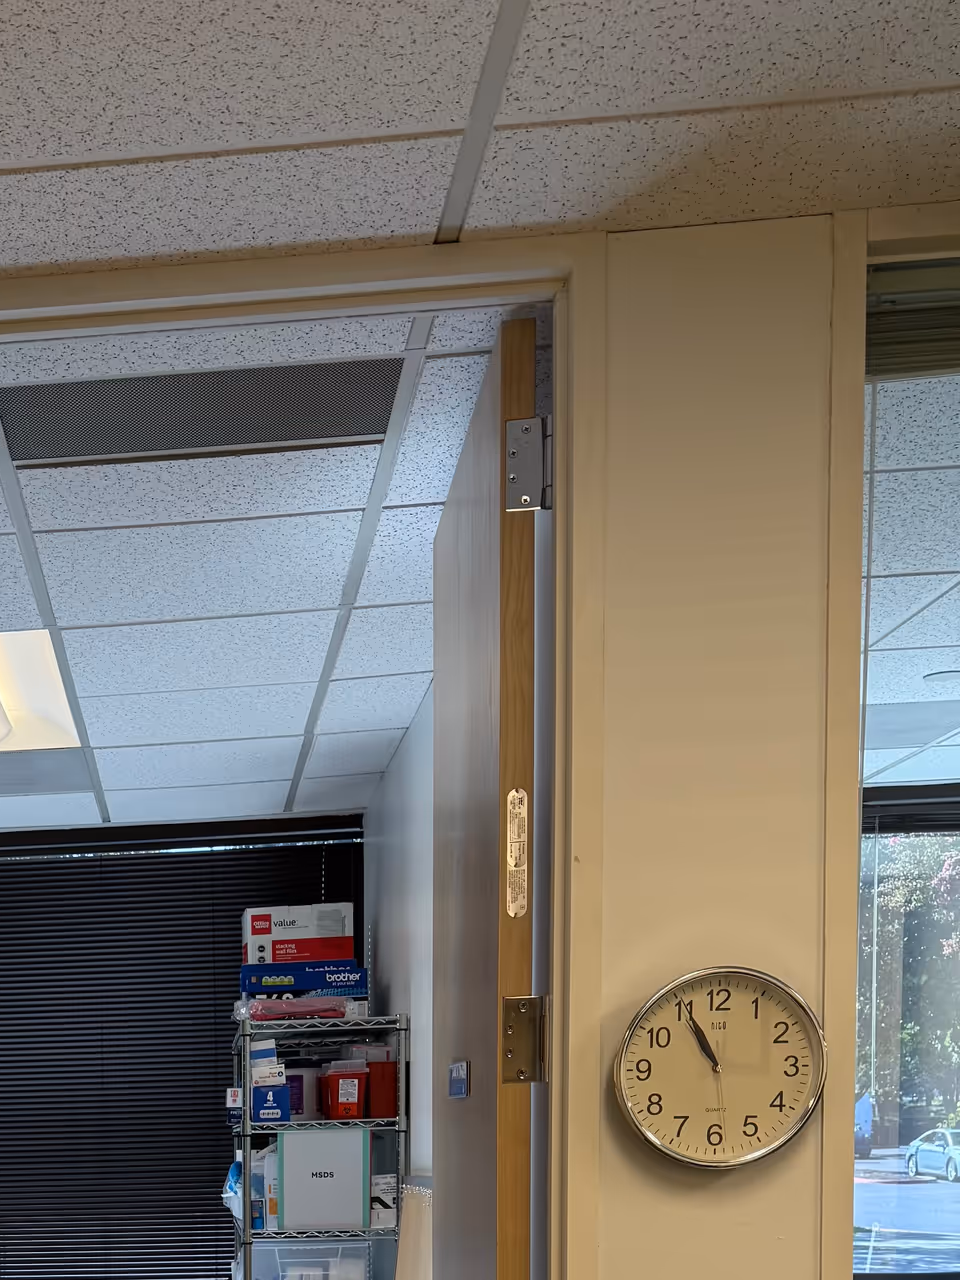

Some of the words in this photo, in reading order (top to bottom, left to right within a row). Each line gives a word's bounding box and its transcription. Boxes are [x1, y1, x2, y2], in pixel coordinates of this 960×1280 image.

[273, 918, 297, 928] value
[326, 972, 361, 982] brother
[674, 999, 693, 1022] 11
[706, 988, 731, 1012] 12
[751, 997, 759, 1020] 1
[646, 1026, 671, 1049] 10
[772, 1021, 789, 1044] 2
[635, 1058, 652, 1081] 9
[783, 1055, 800, 1077] 3
[266, 1091, 274, 1102] 4
[646, 1093, 663, 1116] 8
[769, 1091, 786, 1113] 4
[673, 1115, 689, 1138] 7
[706, 1123, 723, 1146] 6
[742, 1115, 759, 1137] 5
[311, 1171, 335, 1179] MSDS
